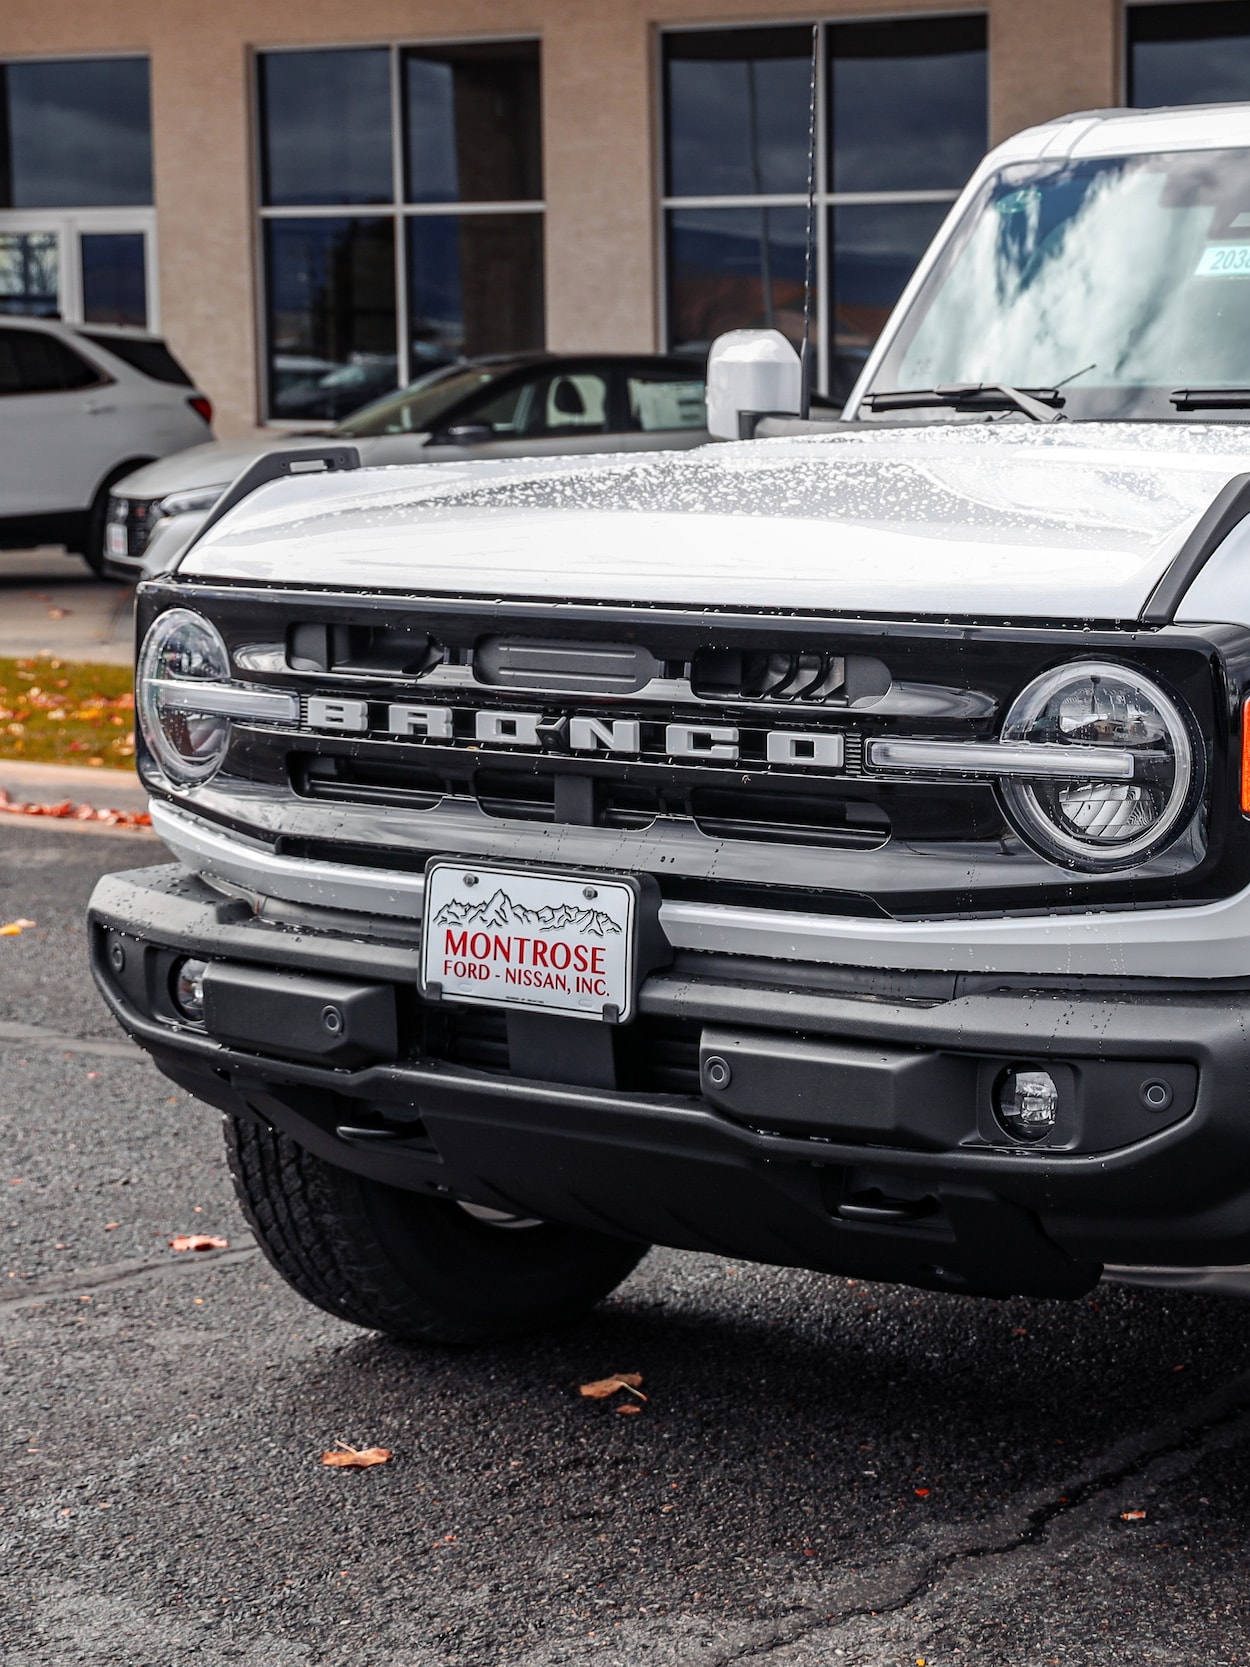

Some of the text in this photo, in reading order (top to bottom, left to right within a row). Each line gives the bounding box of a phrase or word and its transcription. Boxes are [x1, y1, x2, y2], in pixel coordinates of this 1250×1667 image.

[308, 697, 845, 768] BRONCO
[445, 929, 606, 975] MONTROSE
[444, 960, 490, 981] FORD
[505, 967, 571, 994] NISSAN,
[576, 976, 610, 996] INC.
